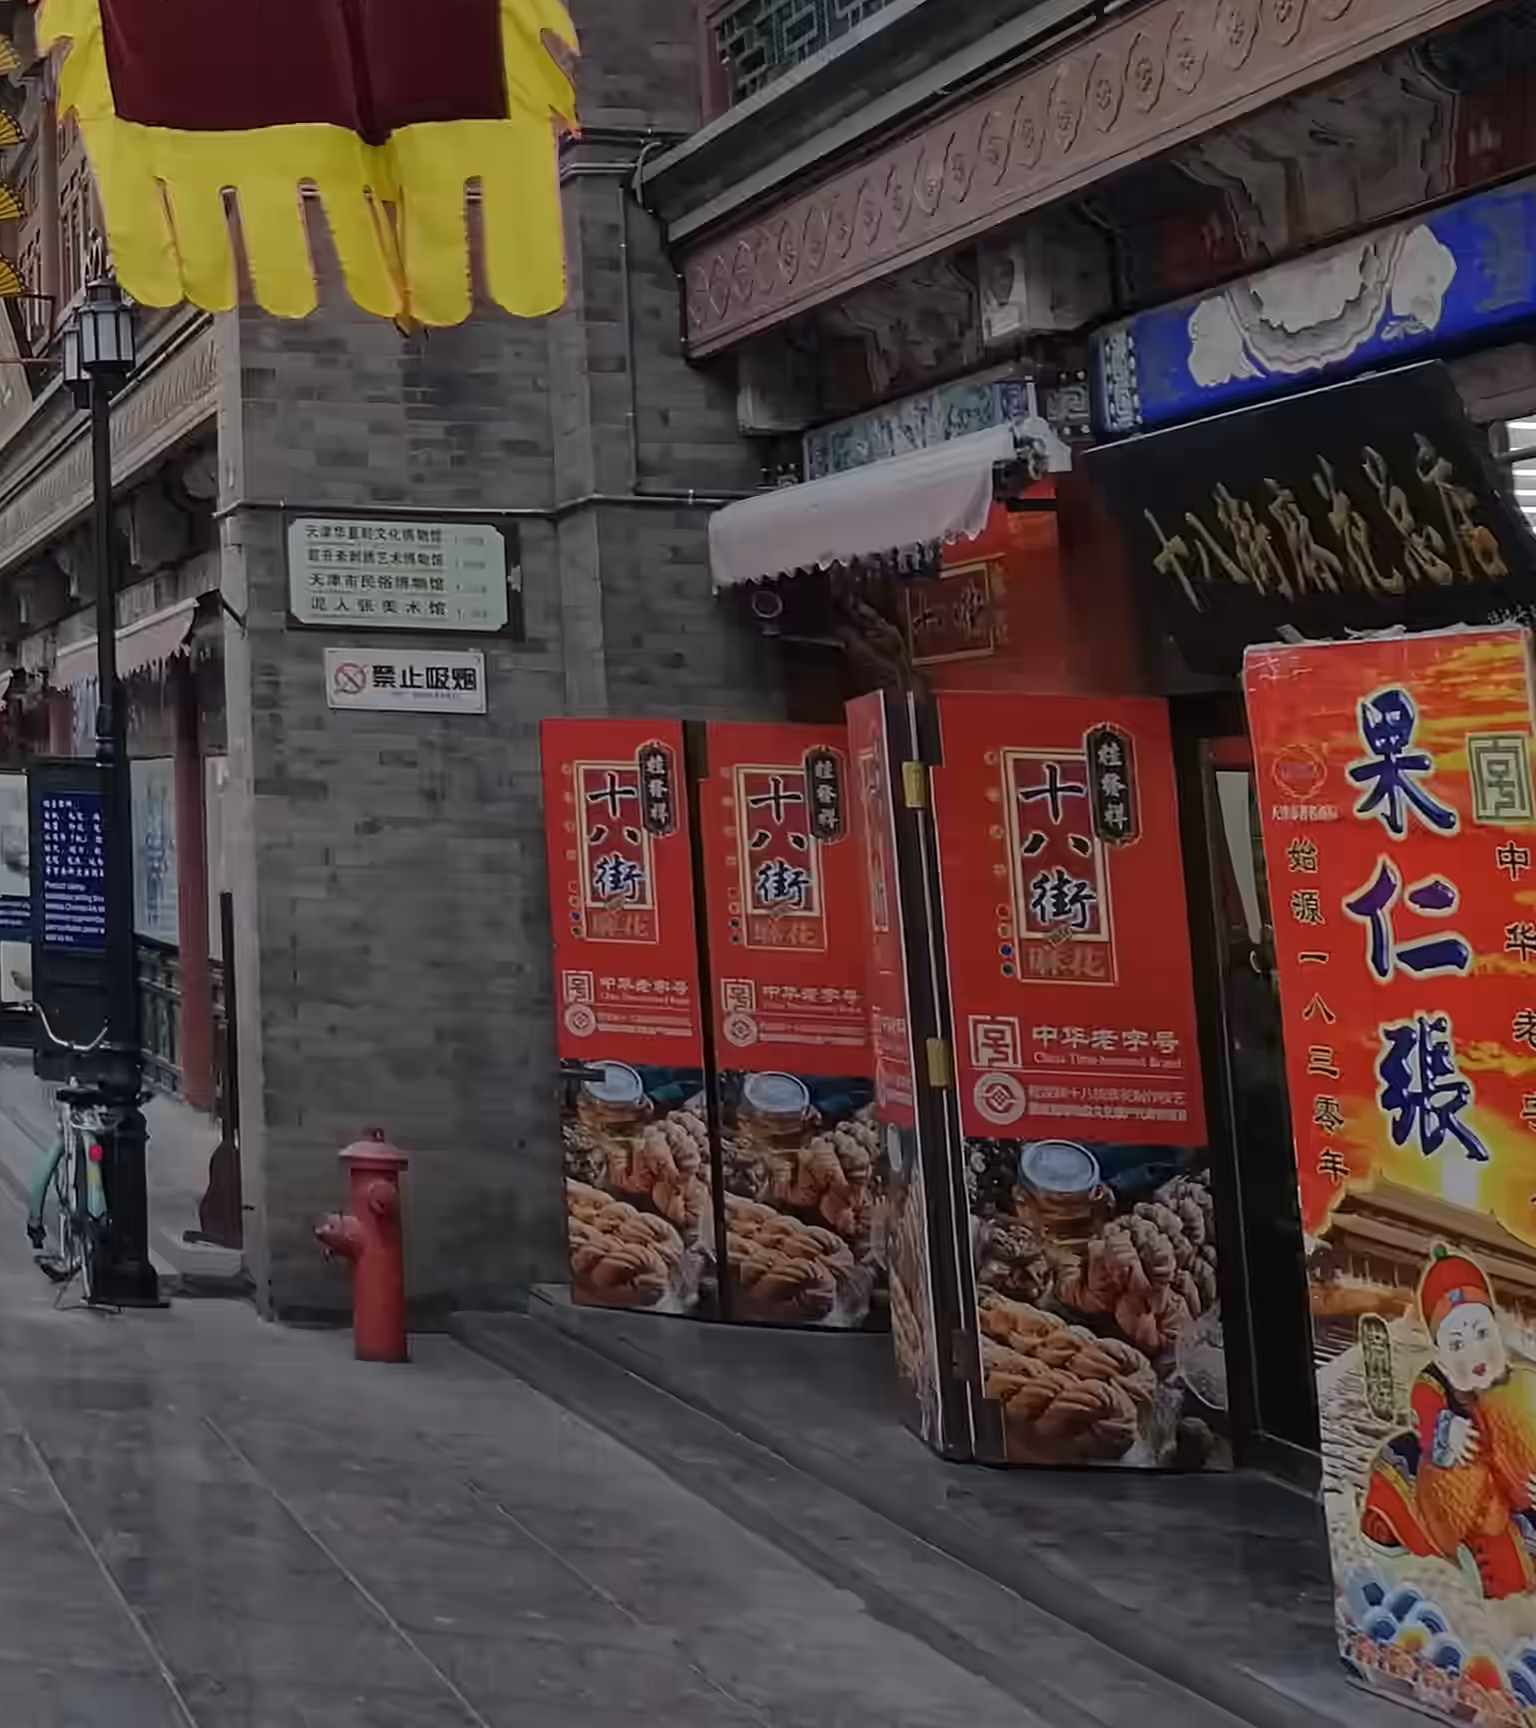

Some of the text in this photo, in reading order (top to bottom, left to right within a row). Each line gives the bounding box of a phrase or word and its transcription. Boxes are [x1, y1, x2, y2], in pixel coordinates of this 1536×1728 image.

[372, 665, 477, 690] 禁止吸烟
[587, 771, 644, 901] 十八街
[749, 775, 810, 907] 十八街
[1018, 763, 1097, 930] 十八街
[1032, 1024, 1180, 1055] 中华老字号
[1288, 838, 1349, 1184] 始源一八三零年
